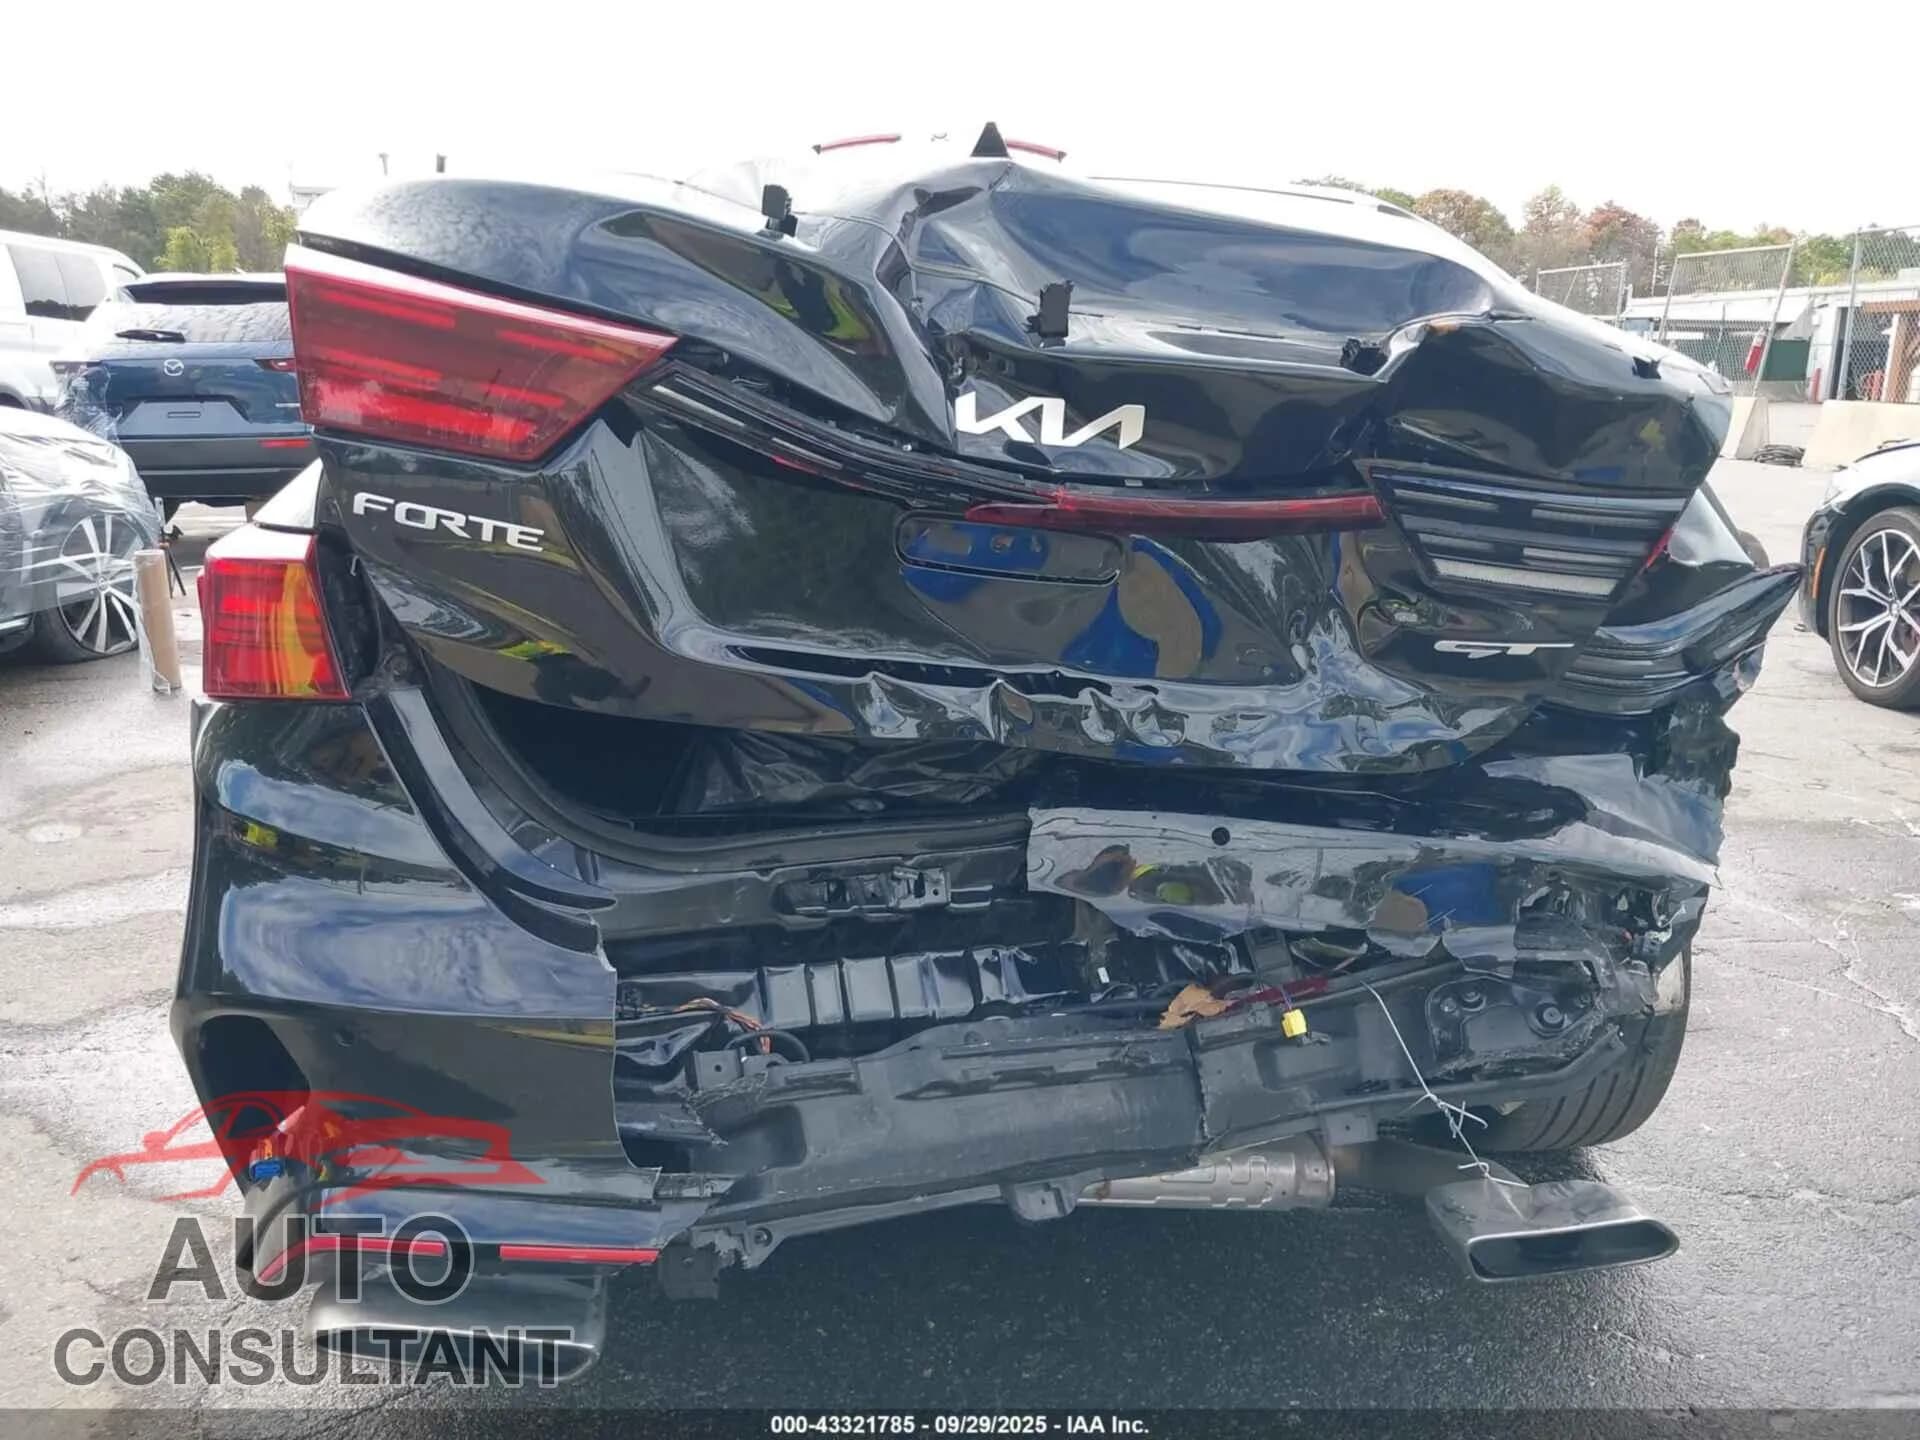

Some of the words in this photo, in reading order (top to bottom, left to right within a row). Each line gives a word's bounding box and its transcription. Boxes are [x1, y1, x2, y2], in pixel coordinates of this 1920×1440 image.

[955, 391, 1145, 450] KIA
[353, 492, 544, 551] FORTE
[1433, 640, 1575, 659] GT
